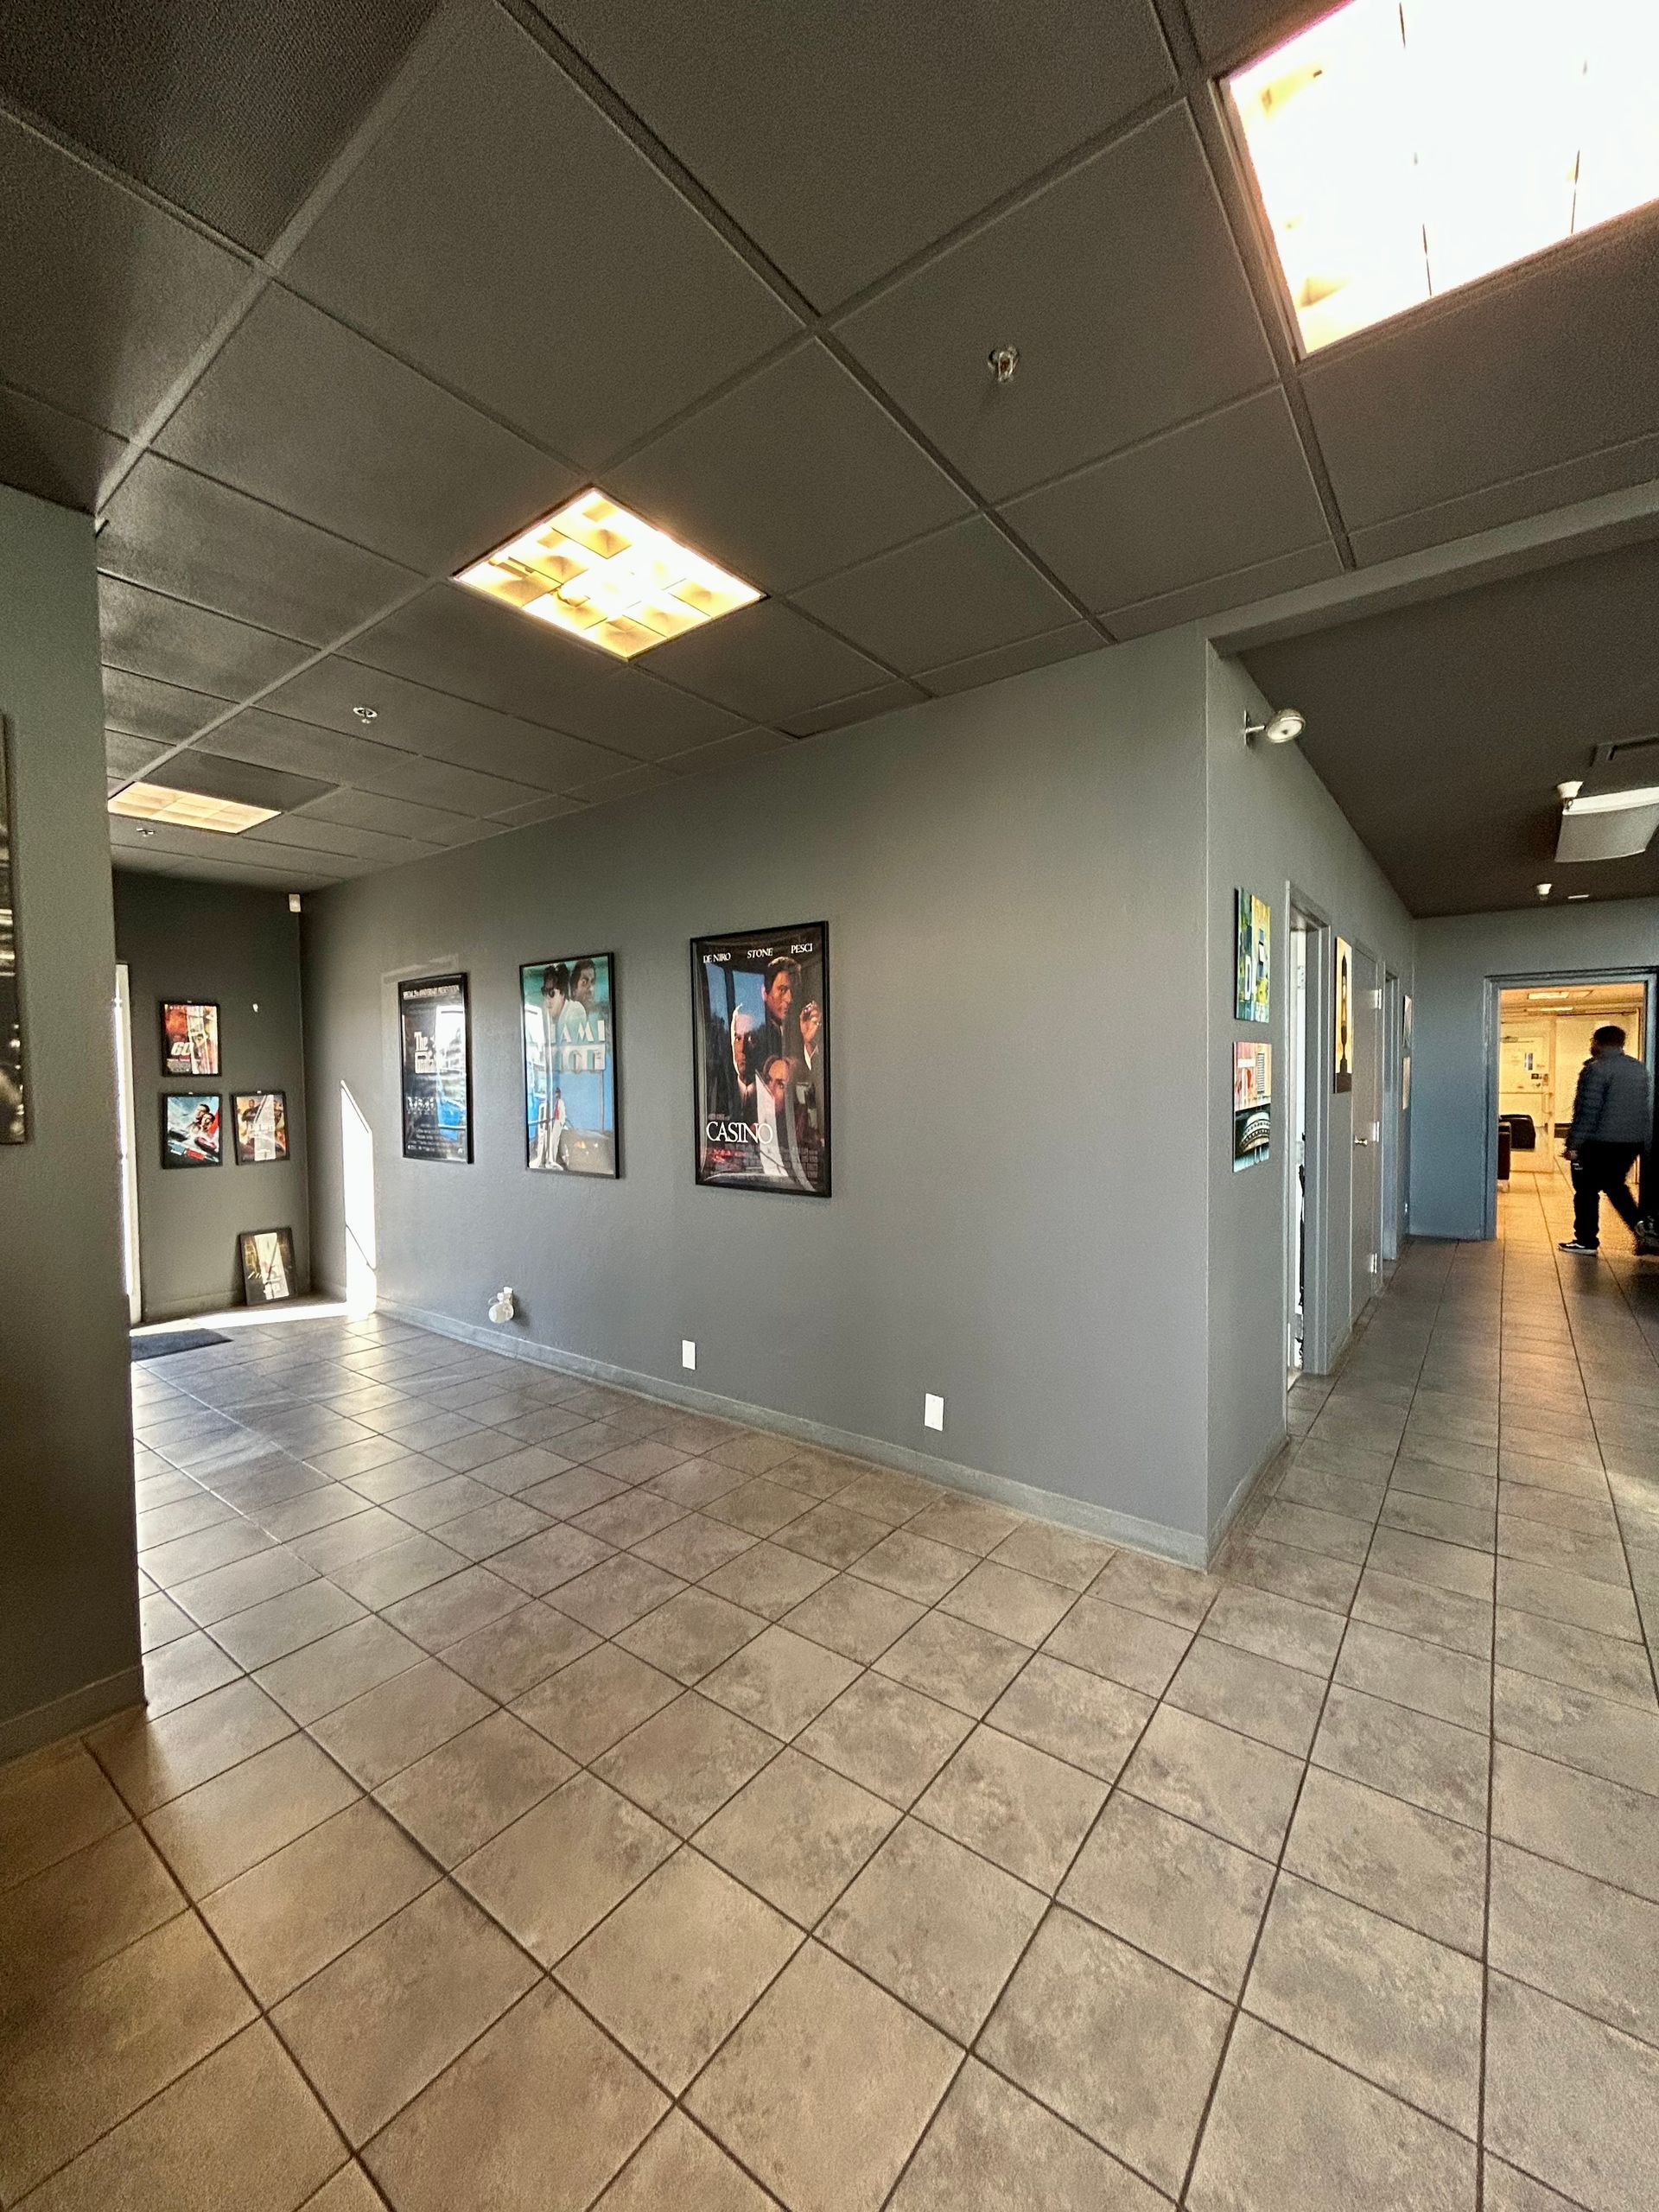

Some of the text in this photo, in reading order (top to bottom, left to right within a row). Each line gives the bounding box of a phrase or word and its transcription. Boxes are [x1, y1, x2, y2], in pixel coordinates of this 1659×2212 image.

[747, 947, 773, 959] STONE
[791, 943, 813, 954] PESCI
[702, 952, 732, 963] DE NIRO
[544, 1020, 606, 1044] IAMI
[706, 1120, 773, 1145] CASINO
